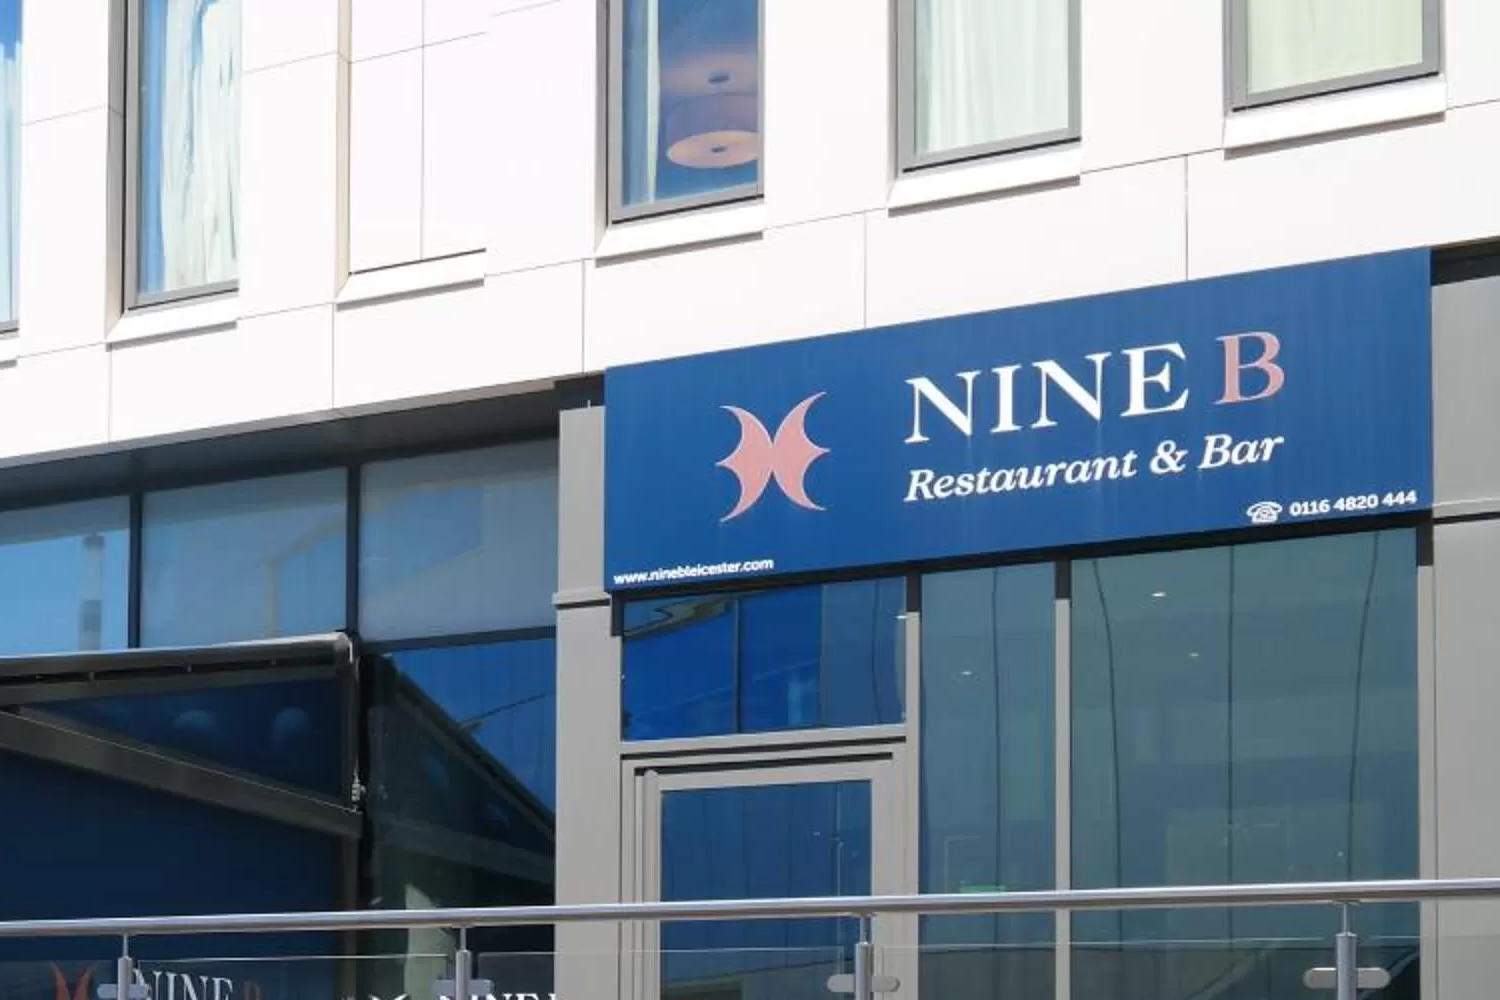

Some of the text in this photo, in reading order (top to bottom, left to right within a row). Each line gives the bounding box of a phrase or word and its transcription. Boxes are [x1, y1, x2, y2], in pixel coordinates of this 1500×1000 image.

[904, 331, 1285, 444] NINE B
[903, 433, 1285, 503] Restaurant & Bar
[1289, 489, 1418, 517] 0116 4820 444
[613, 558, 775, 585] www.ninebleicester.com
